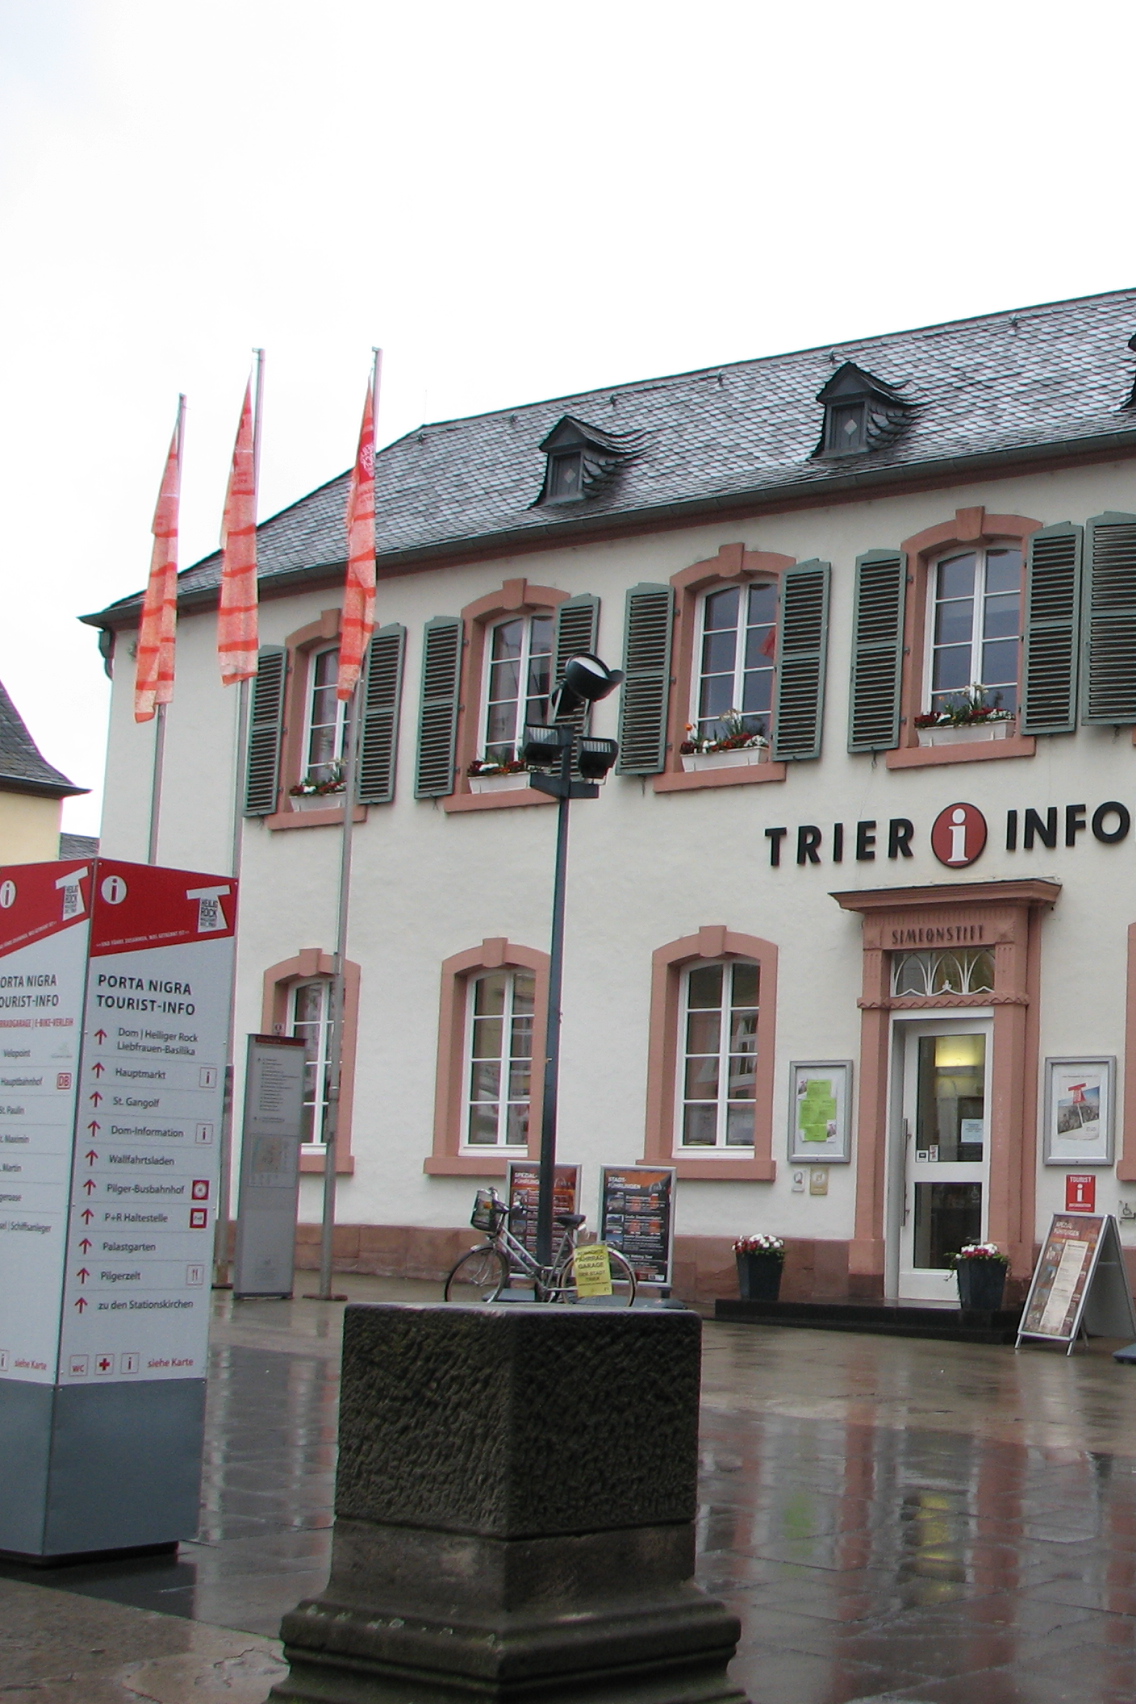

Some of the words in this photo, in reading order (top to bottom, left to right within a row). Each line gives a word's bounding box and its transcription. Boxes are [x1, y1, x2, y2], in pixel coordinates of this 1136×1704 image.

[765, 817, 914, 868] TRIER
[0, 975, 24, 988] ORTA
[26, 974, 57, 987] NIGRA
[98, 974, 144, 991] PORTA
[149, 979, 192, 996] NIGRA
[0, 994, 59, 1008] OURIST-INFO
[96, 994, 196, 1016] TOURIST-INFO
[118, 1027, 139, 1037] Dom
[145, 1029, 177, 1042] Heiliger
[179, 1032, 198, 1043] Rock
[117, 1041, 196, 1056] Liebfrauen-Basilika
[115, 1067, 166, 1080] Hauptmarkt
[113, 1096, 124, 1106] St.
[126, 1096, 160, 1110] Gangolf
[111, 1125, 184, 1137] Dom-Information
[108, 1154, 175, 1166] Wallfahrtsladen
[107, 1183, 185, 1195] Pilger-Busbahnhof
[104, 1212, 122, 1221] P+R
[124, 1212, 168, 1222] Haltestelle
[102, 1241, 156, 1252] Palastgarten
[98, 1302, 109, 1310] zu
[110, 1300, 127, 1310] den
[129, 1299, 194, 1310] Stationskirchen
[147, 1359, 170, 1368] siehe
[171, 1357, 194, 1367] Karte
